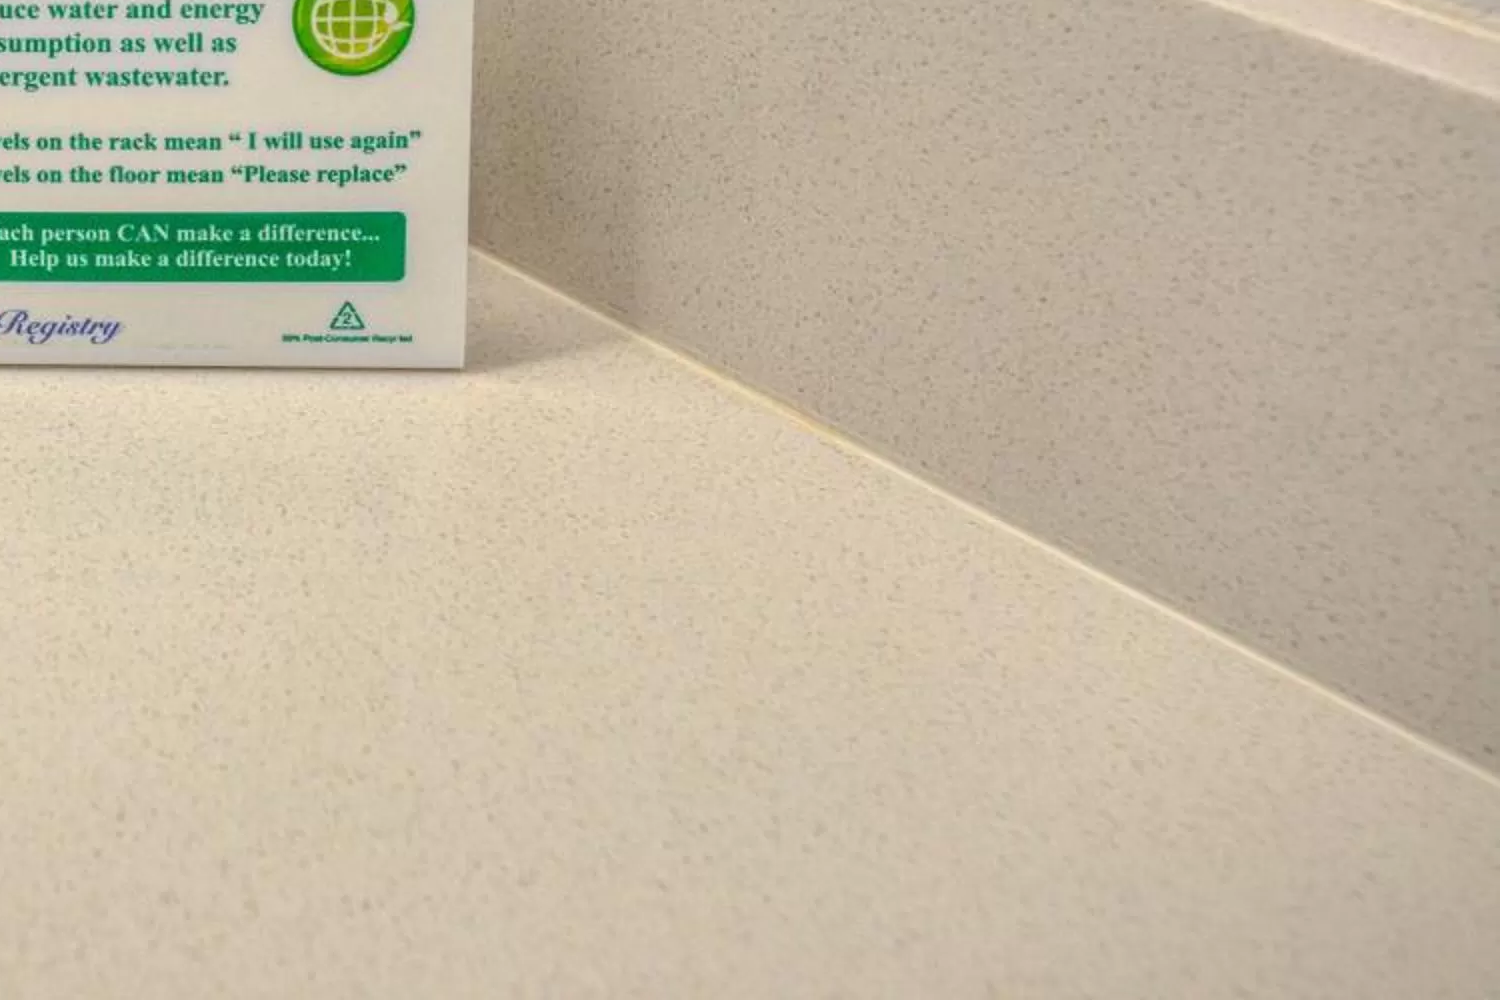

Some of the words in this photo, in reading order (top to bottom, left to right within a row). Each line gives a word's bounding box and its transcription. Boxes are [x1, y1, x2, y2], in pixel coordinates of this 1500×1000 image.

[48, 0, 117, 20] water
[180, 3, 264, 25] energy
[120, 38, 146, 53] as
[153, 32, 203, 53] well
[211, 37, 237, 53] as
[86, 67, 229, 88] wastewater.
[36, 137, 62, 151] on
[69, 132, 103, 151] the
[109, 132, 157, 151] rack
[164, 136, 223, 151] mean
[263, 131, 303, 150] will
[309, 135, 344, 150] use
[36, 170, 63, 184] on
[69, 165, 103, 184] the
[109, 164, 161, 184] floor
[166, 169, 224, 184] mean
[41, 229, 110, 247] person
[117, 225, 170, 242] CAN
[177, 224, 234, 242] make
[239, 230, 252, 242] a
[10, 249, 60, 271] Help
[66, 254, 89, 266] us
[95, 249, 151, 267] make
[157, 255, 170, 267] a
[175, 249, 280, 267] difference
[285, 249, 352, 271] today!
